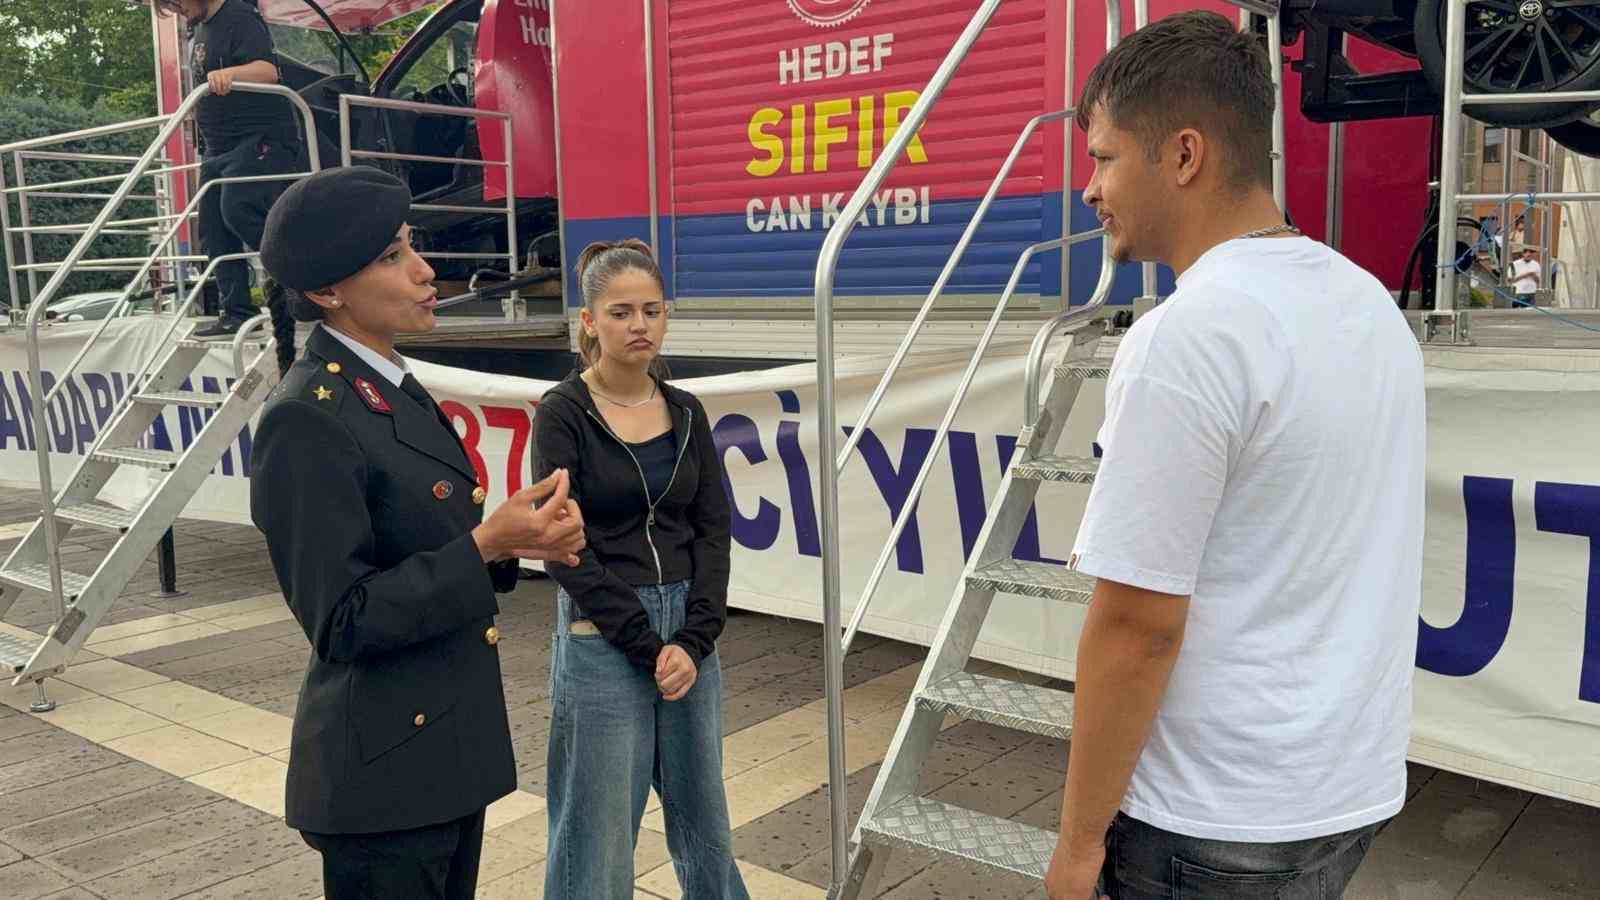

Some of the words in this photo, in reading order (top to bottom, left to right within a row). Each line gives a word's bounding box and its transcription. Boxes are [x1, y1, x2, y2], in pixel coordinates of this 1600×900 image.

[778, 32, 894, 85] HEDEF
[745, 89, 929, 177] SIFIR
[746, 194, 811, 233] CAN
